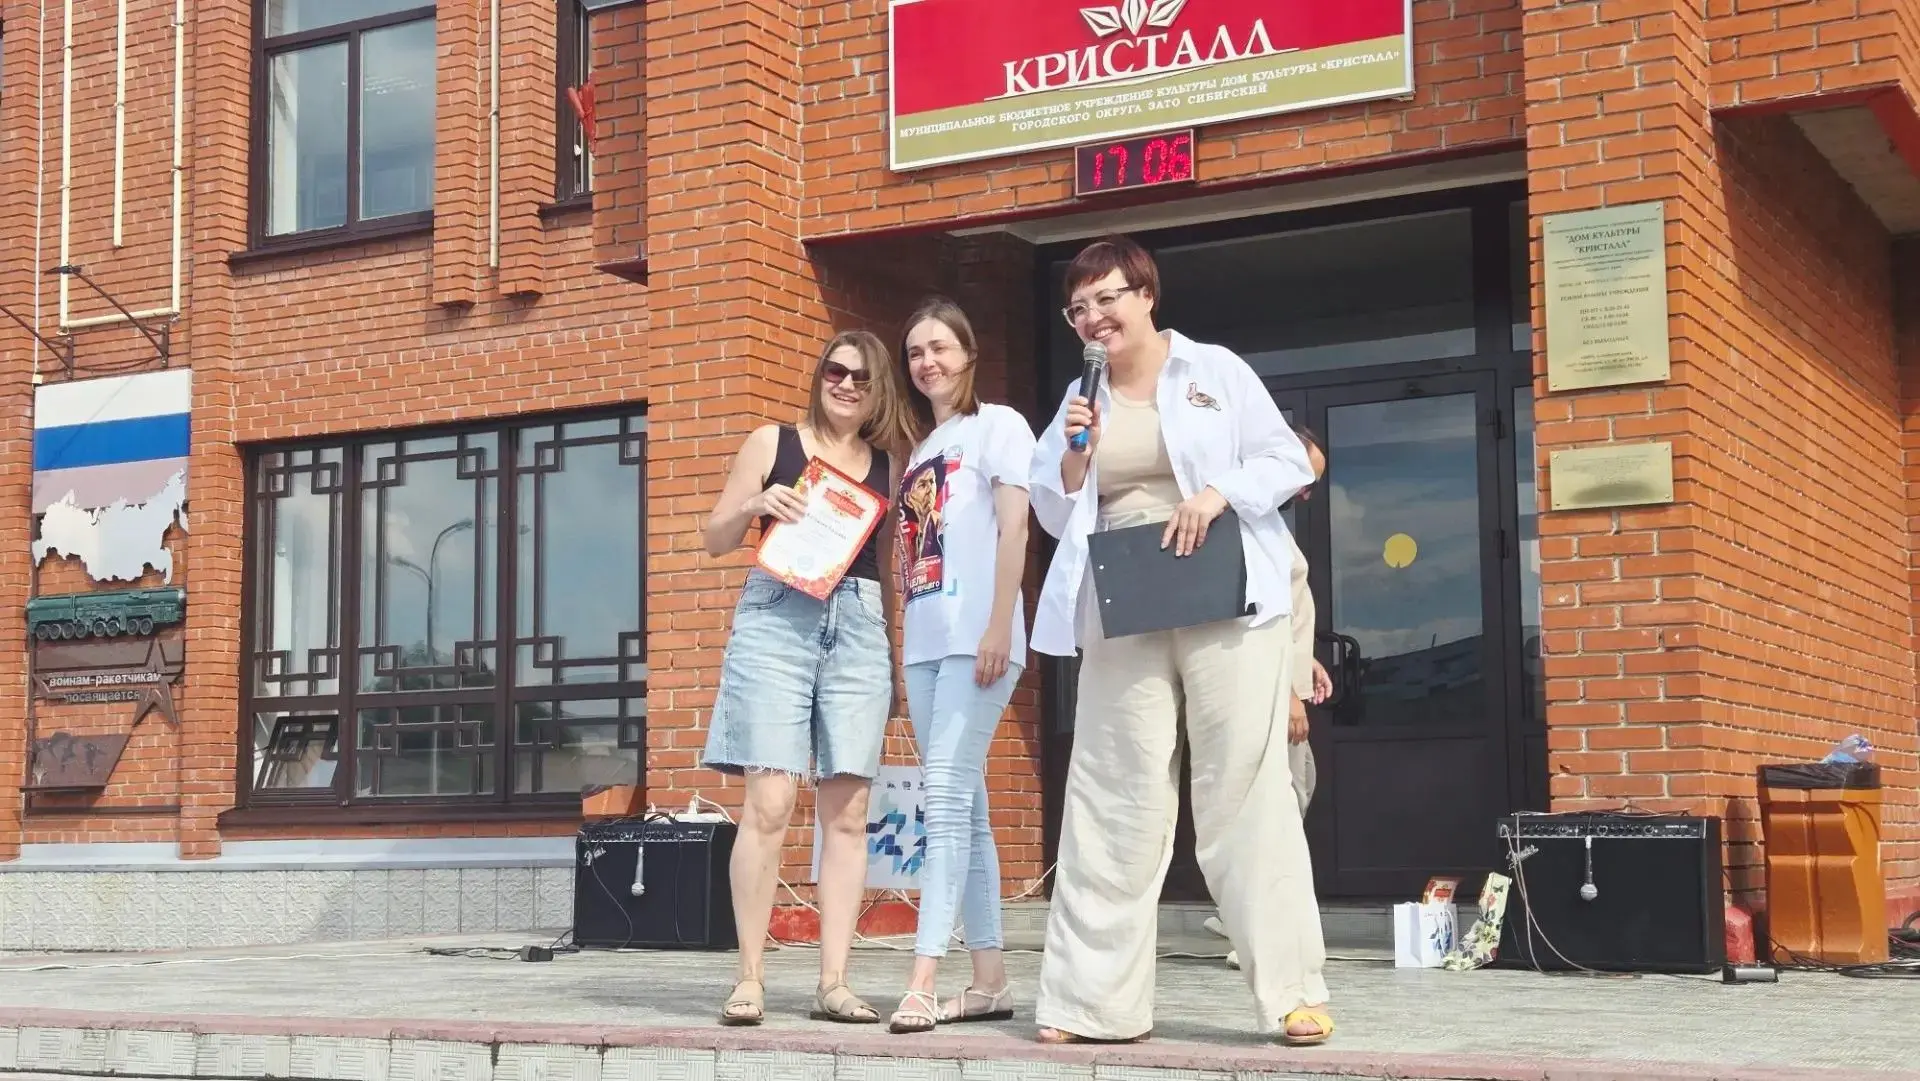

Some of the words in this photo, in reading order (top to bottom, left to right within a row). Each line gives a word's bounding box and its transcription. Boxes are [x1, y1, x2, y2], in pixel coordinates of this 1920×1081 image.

[1003, 18, 1277, 96] КРИСТАЛЛ
[900, 114, 995, 138] МУНИЦИПАЛЬНОЕ
[999, 102, 1071, 122] БЮДЖЕТНОЕ
[1075, 89, 1154, 110] УЧРЕЖДЕНИЕ
[1156, 79, 1217, 97] КУЛЬТУРЫ
[1220, 73, 1248, 87] ДОМ
[1252, 62, 1317, 83] КУЛЬТУРЫ
[1321, 50, 1400, 70] «КРИСТАЛЛ»
[1012, 112, 1090, 132] ГОРОДСКОГО
[1096, 104, 1142, 119] ОКРУГА
[1148, 98, 1181, 111] ЗАТО
[1188, 83, 1268, 105] СИБИРСКИЙ
[1592, 227, 1641, 240] КУЛЬТУРЫ
[49, 672, 162, 688] воинам-ракетчикам
[64, 690, 141, 703] посвящается
